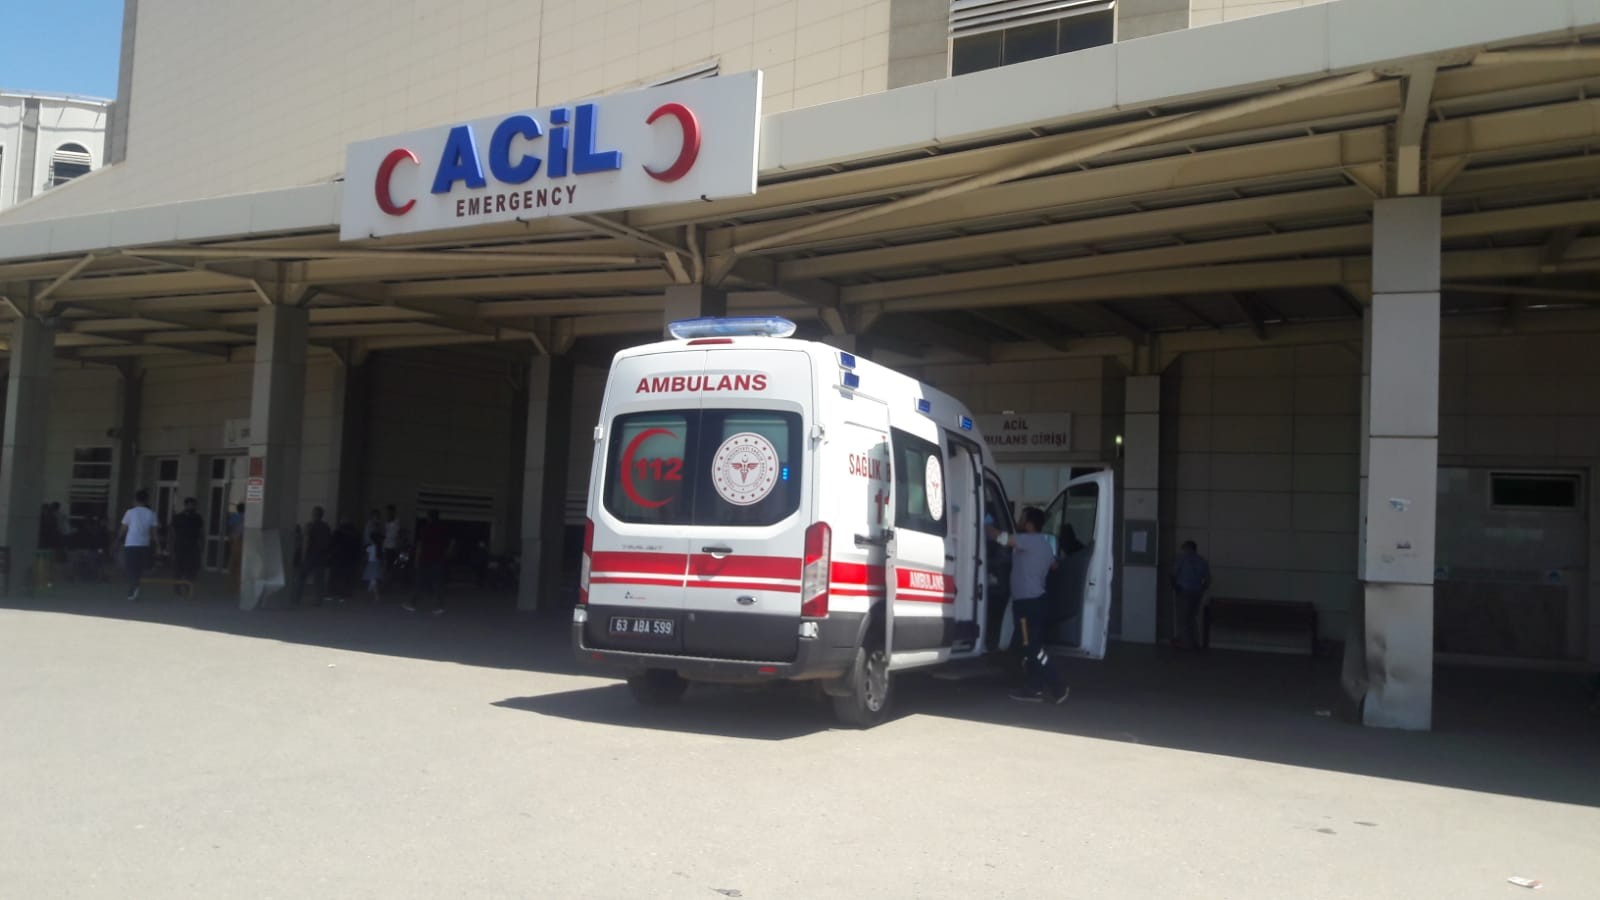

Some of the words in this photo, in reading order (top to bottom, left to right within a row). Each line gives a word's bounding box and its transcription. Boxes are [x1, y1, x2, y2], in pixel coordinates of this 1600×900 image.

[456, 185, 577, 217] EMERGENCY
[635, 374, 767, 394] AMBULANS
[634, 457, 683, 480] 112
[848, 452, 881, 480] SAĞLIK
[910, 570, 945, 591] AMBULANS
[616, 619, 628, 632] 63
[633, 620, 650, 633] ABA
[653, 621, 672, 635] 599
